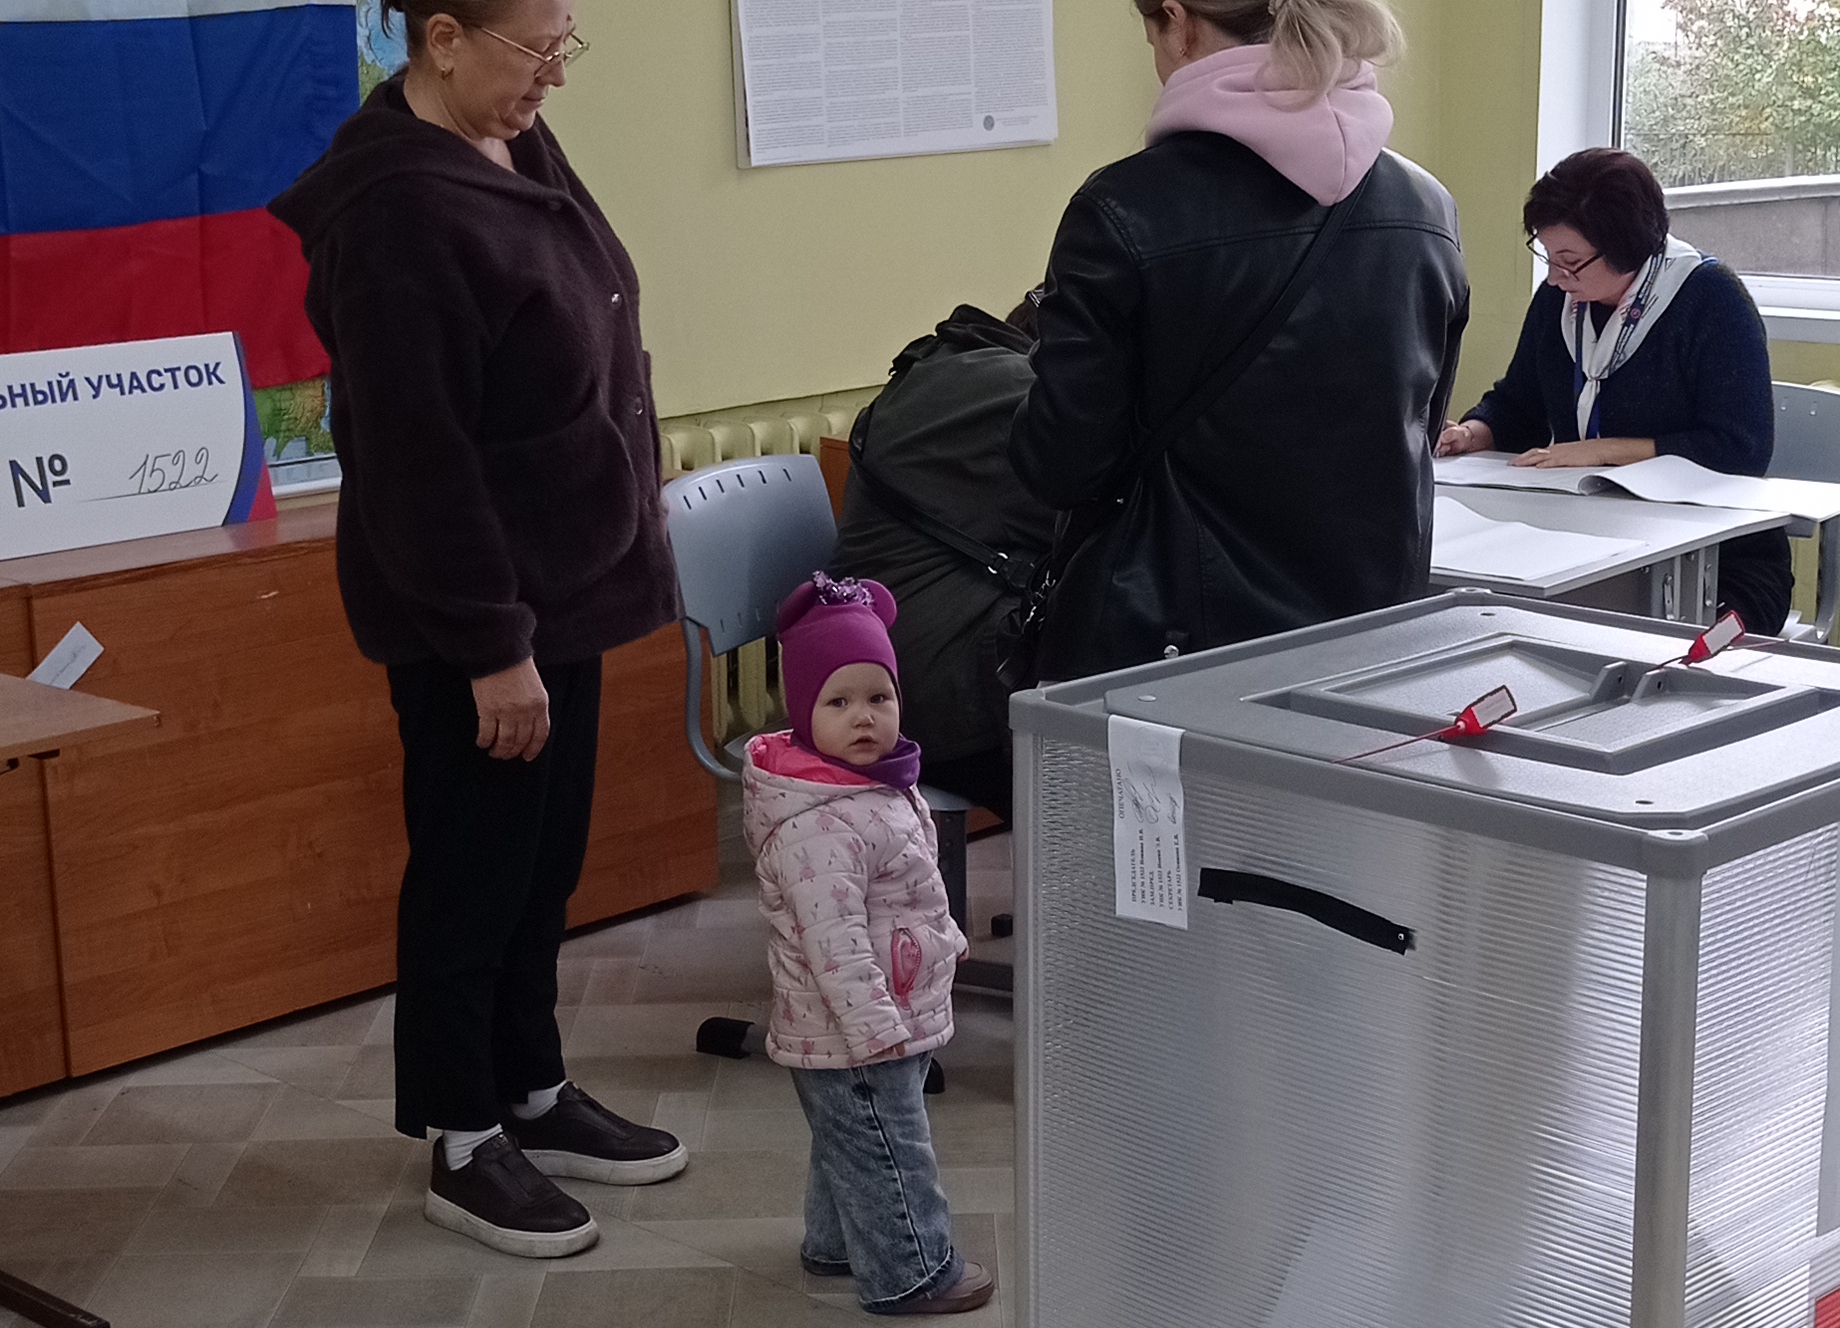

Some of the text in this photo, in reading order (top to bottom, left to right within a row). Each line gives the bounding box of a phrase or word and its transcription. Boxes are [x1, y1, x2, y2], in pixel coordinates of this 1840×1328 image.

[84, 361, 226, 400] УЧАСТОК
[9, 446, 219, 508] № 1522
[1115, 768, 1125, 819] ОПЕЧАТАНО
